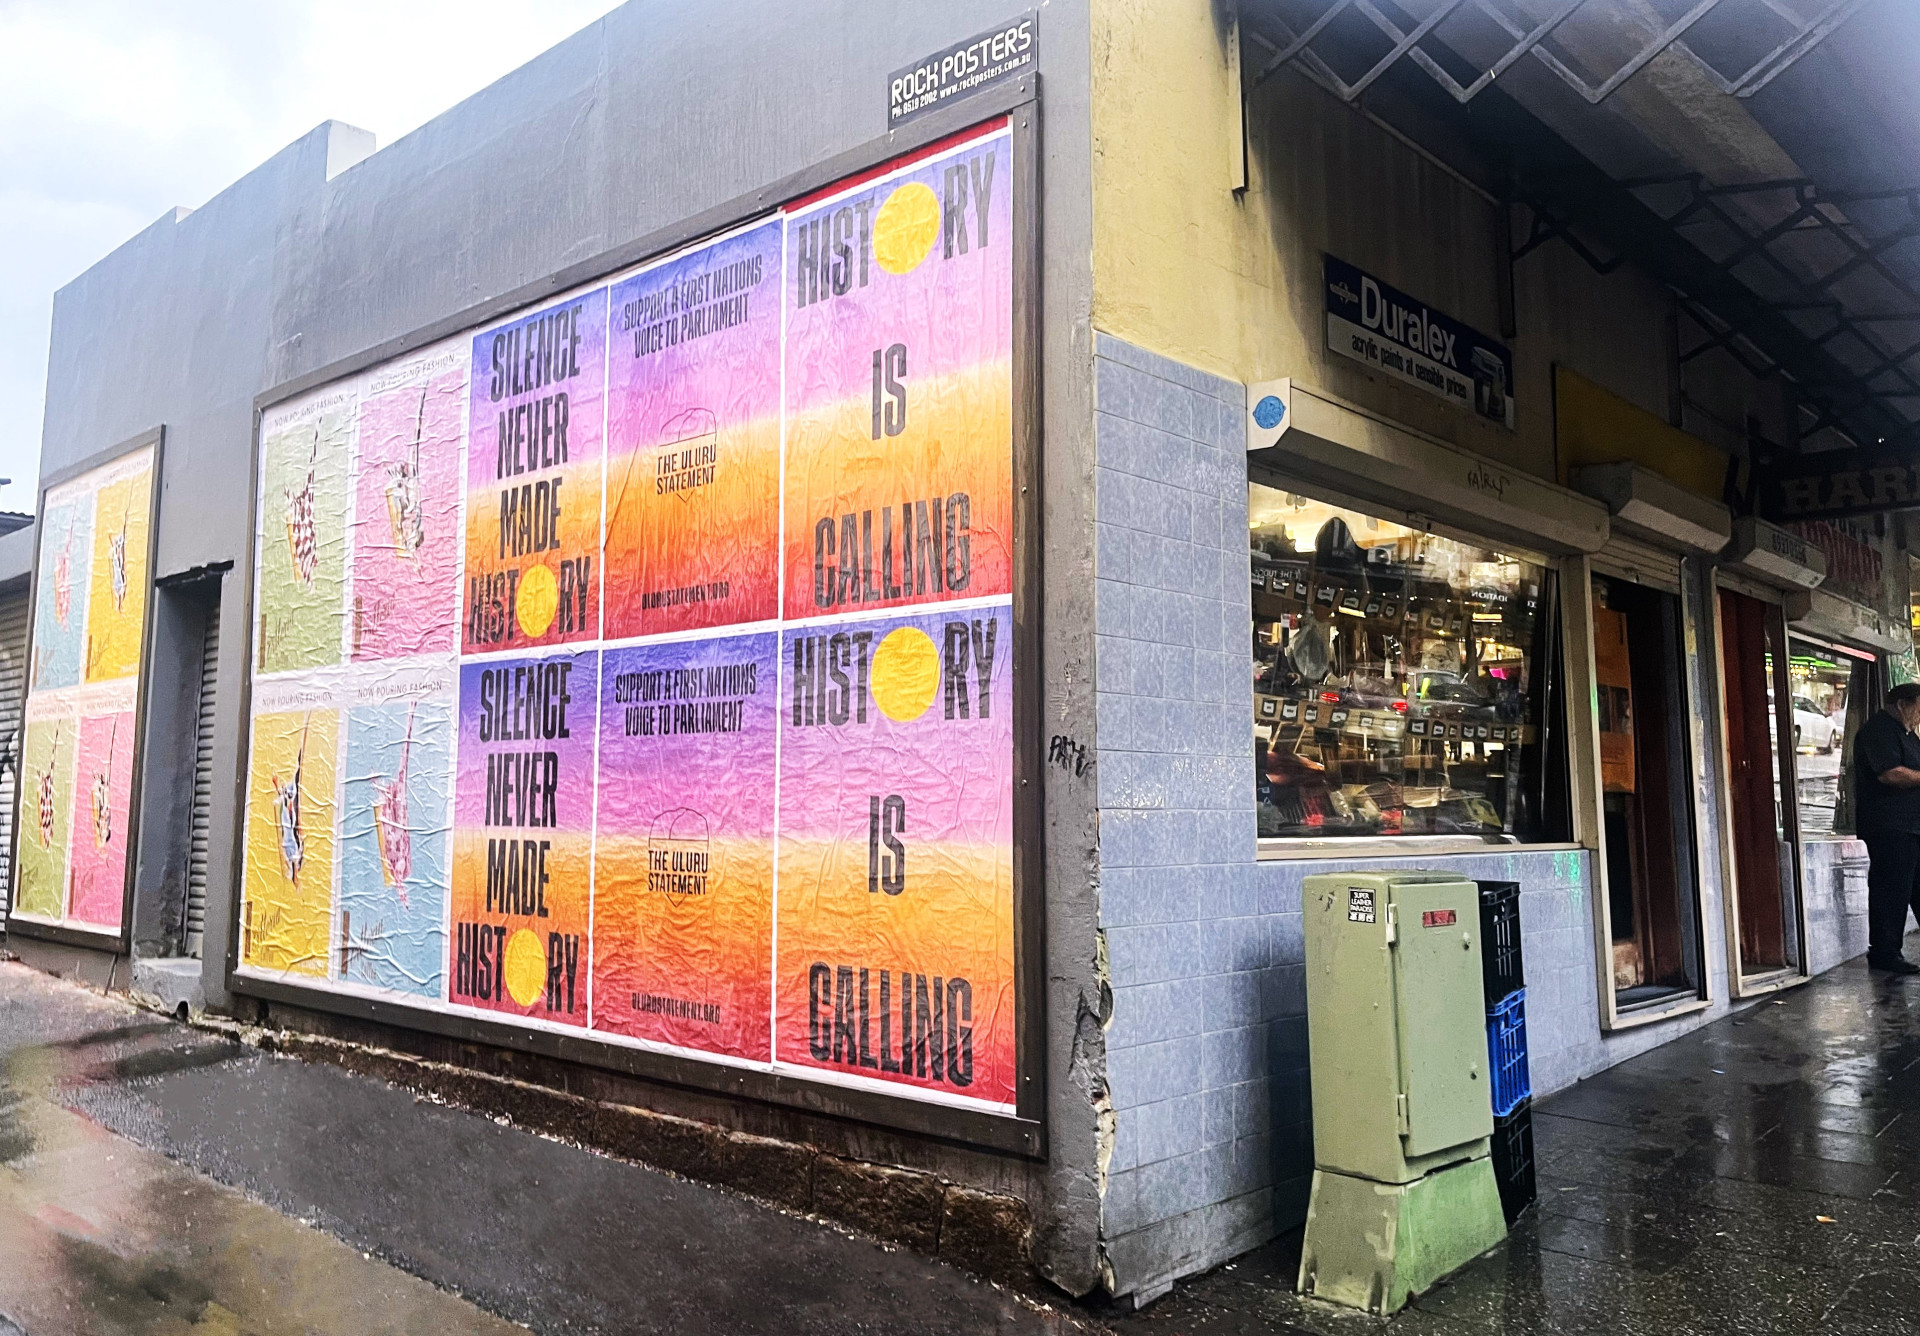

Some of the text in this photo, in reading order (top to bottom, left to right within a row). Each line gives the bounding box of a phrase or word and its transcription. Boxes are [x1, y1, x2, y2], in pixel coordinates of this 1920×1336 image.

[892, 21, 1031, 106] ROCK POSTERS
[892, 107, 902, 119] PH:
[920, 89, 938, 108] 2002
[940, 52, 1031, 99] www.rockposters.com.au
[624, 254, 762, 331] SUPPORT A FIRST NATIONS
[634, 292, 749, 359] VOICE TO PARLIAMENT
[1361, 275, 1458, 368] Duralex
[422, 354, 455, 374] FASHION
[490, 303, 583, 403] SILENCE
[1352, 334, 1467, 399] acrylic paints at sensible prices
[316, 394, 344, 411] FASHION
[872, 342, 907, 441] IS
[497, 392, 569, 480] NEVER
[657, 444, 717, 475] THE ULURU
[656, 466, 715, 495] STATEMENT
[1781, 465, 1920, 515] HAR
[500, 477, 563, 560] MADE
[814, 491, 970, 609] CALLING
[357, 688, 374, 698] NOW
[376, 683, 407, 697] POURING
[479, 662, 572, 743] SILENCE
[615, 663, 757, 703] SUPPORT A FIRST NATIONS
[625, 700, 744, 736] VOICE TO PARLIAMENT
[485, 752, 558, 828] NEVER
[486, 839, 550, 918] MADE
[648, 850, 709, 874] THE ULURU
[868, 794, 906, 897] IS
[648, 873, 708, 895] STATEMENT
[808, 961, 973, 1087] CALLING
